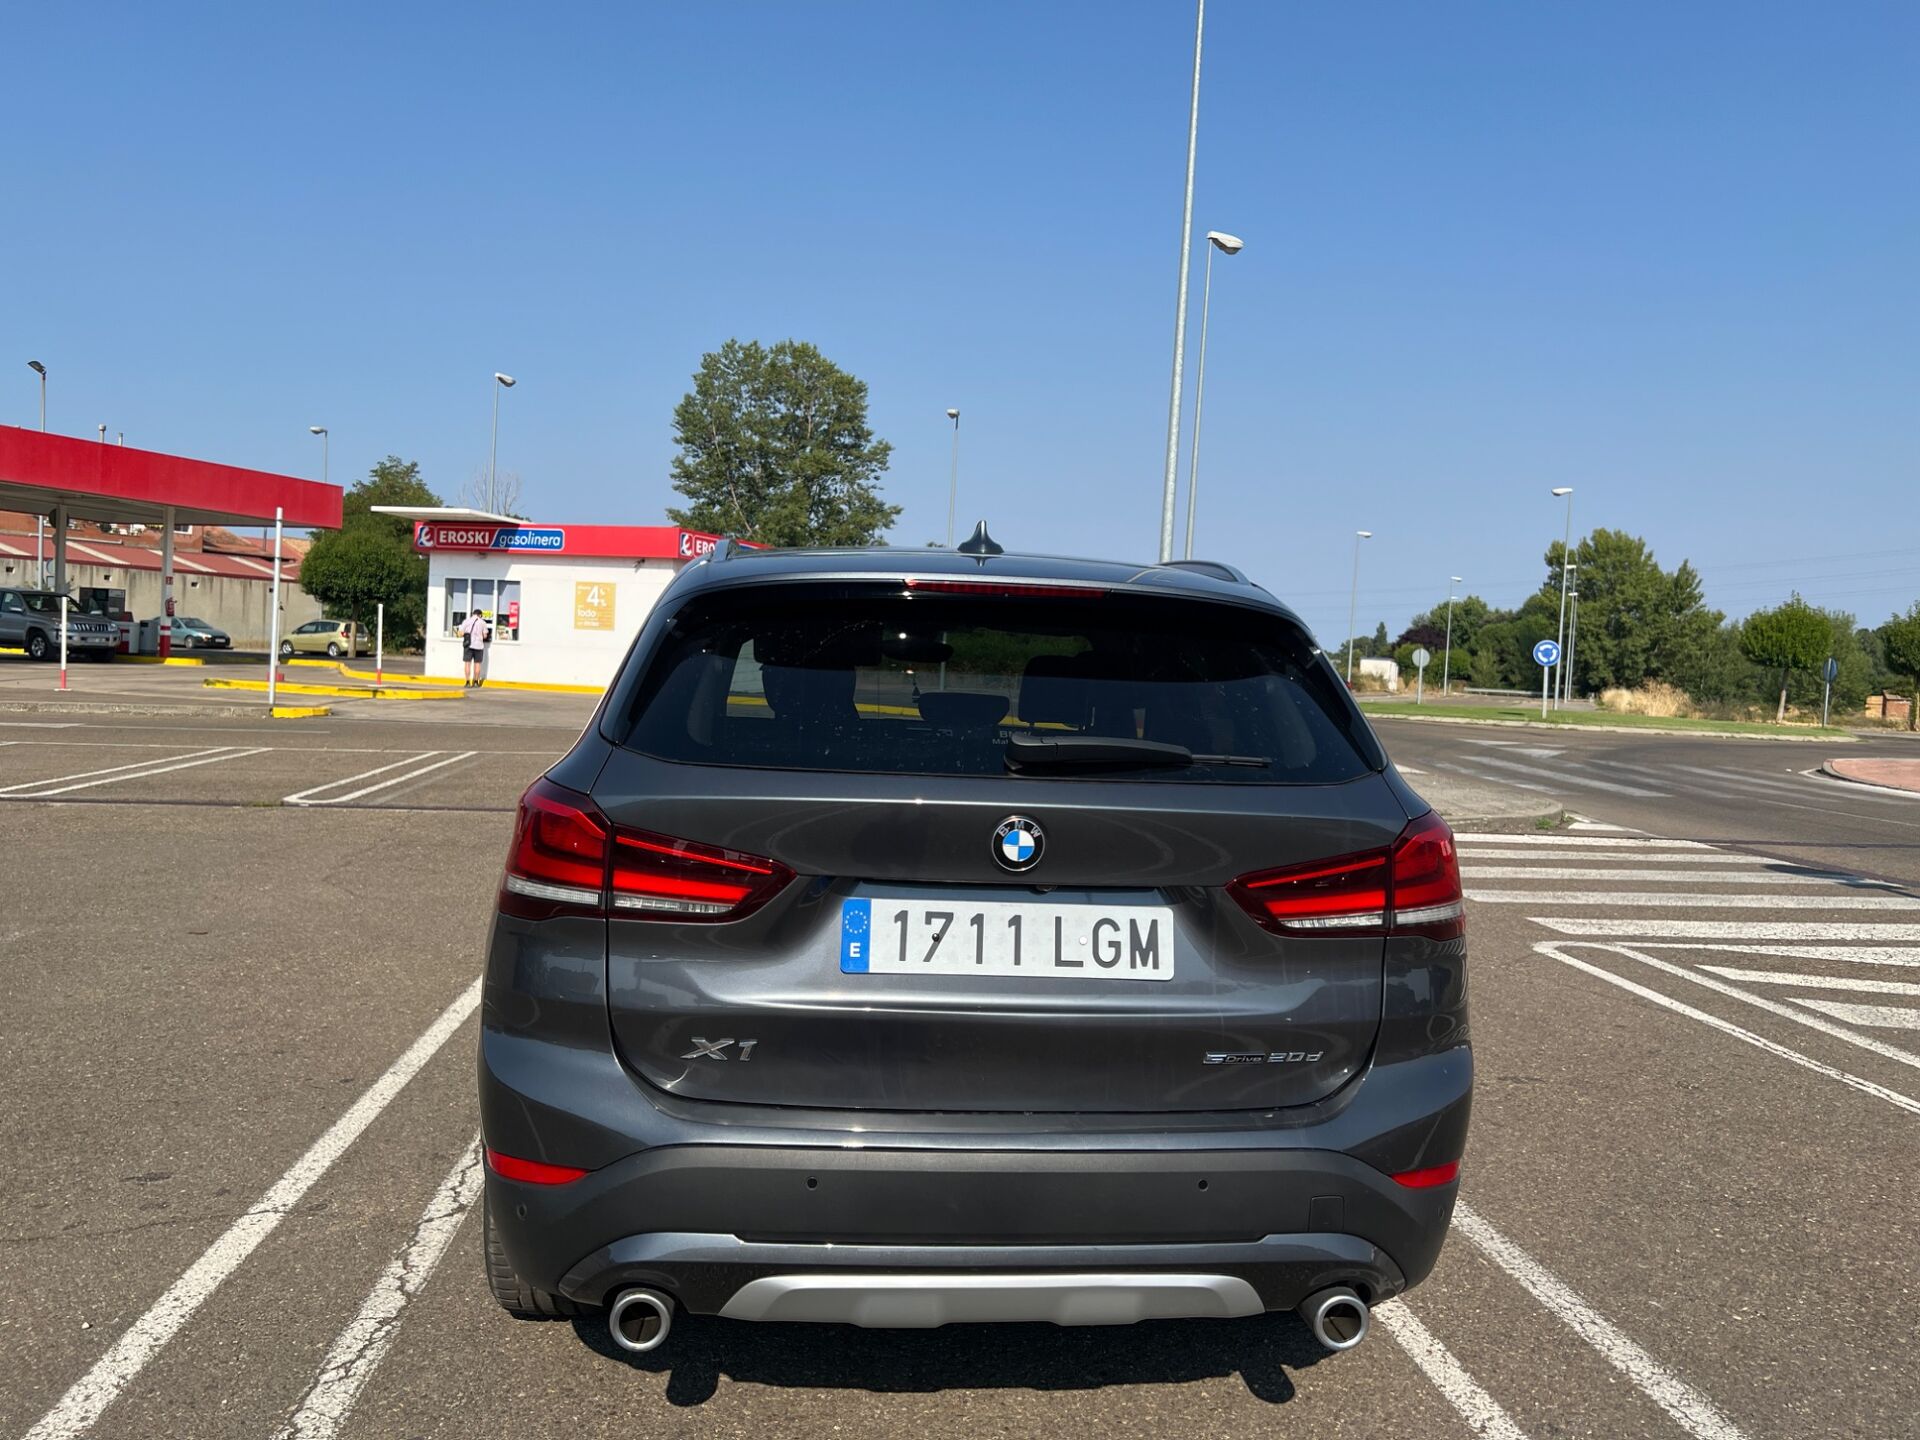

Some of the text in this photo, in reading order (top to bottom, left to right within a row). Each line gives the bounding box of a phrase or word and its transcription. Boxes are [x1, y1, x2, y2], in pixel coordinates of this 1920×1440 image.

[439, 530, 489, 544] EROSKI
[500, 531, 561, 547] gasolinera
[696, 540, 716, 554] ERO
[997, 819, 1042, 838] BMW
[893, 909, 1160, 970] 1711 LGM
[850, 942, 861, 957] E
[680, 1037, 758, 1061] X1
